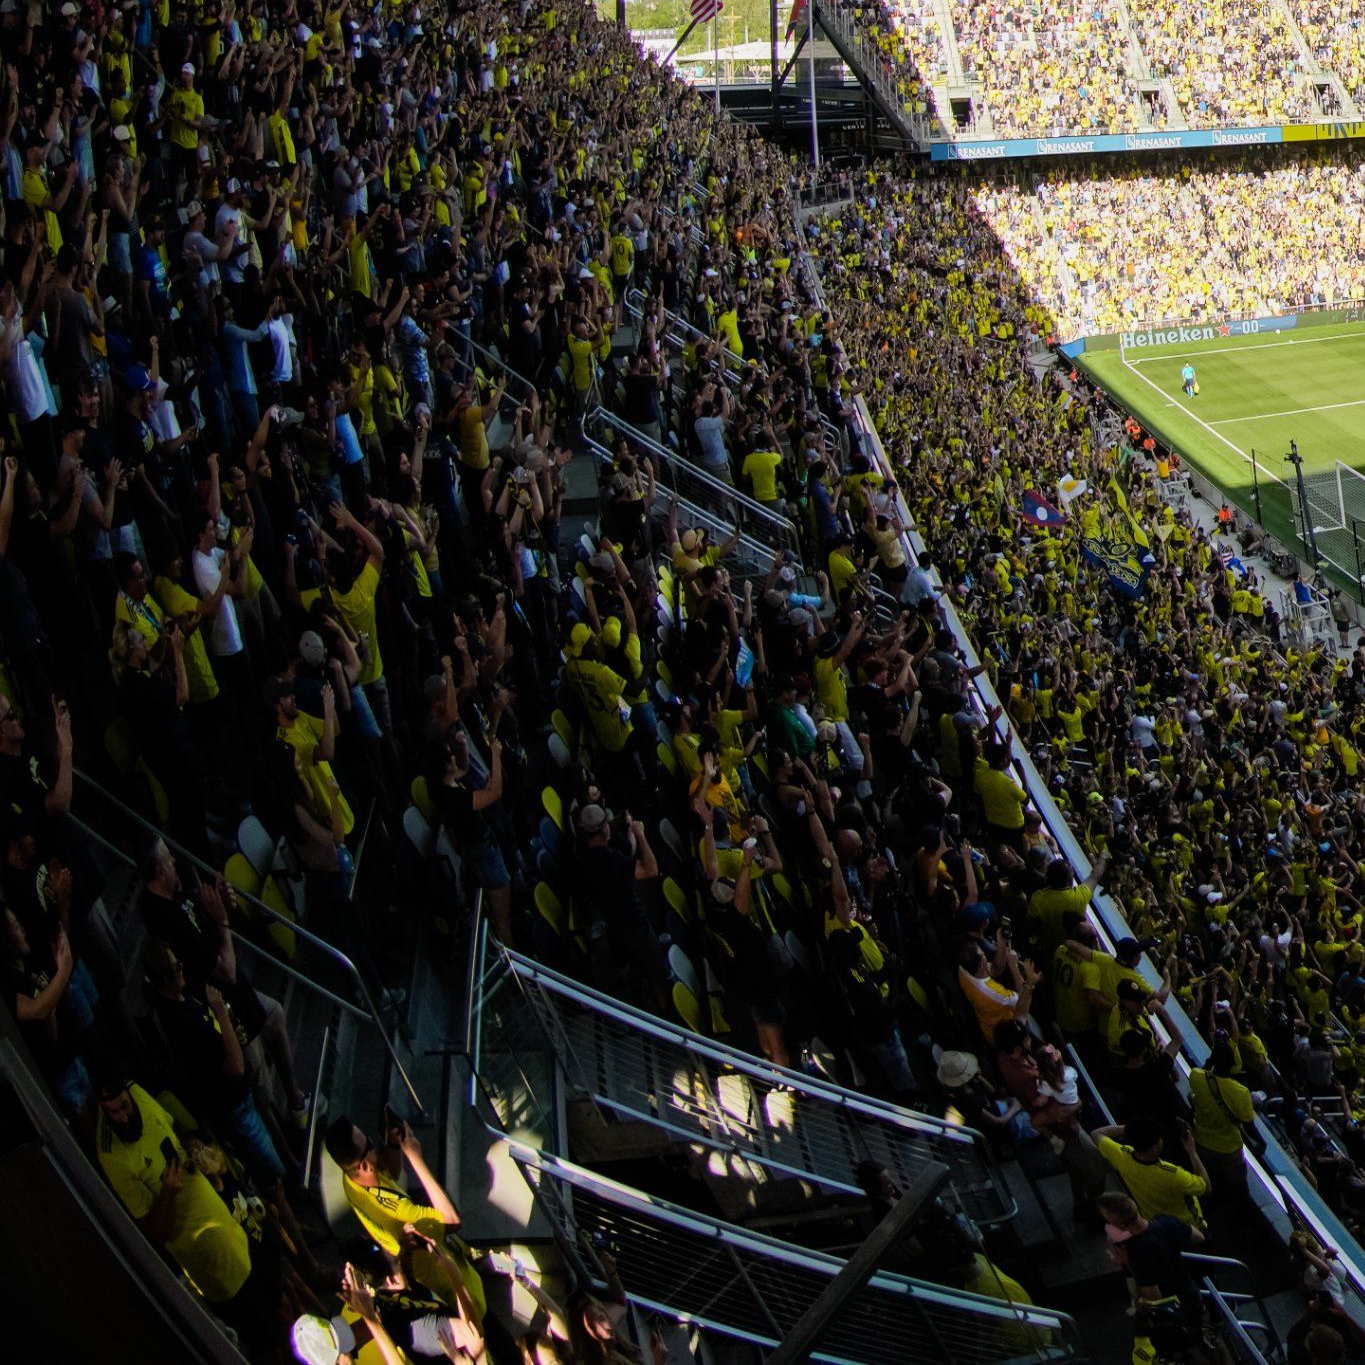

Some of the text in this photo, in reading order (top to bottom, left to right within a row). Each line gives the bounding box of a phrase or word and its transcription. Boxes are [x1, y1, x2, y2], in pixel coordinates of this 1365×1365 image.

[1135, 136, 1182, 148] RENASANT
[1221, 132, 1268, 143] RENASANT
[957, 146, 1006, 160] RENASANT
[1046, 141, 1095, 154] RENASANT
[1122, 326, 1215, 349] Heineken
